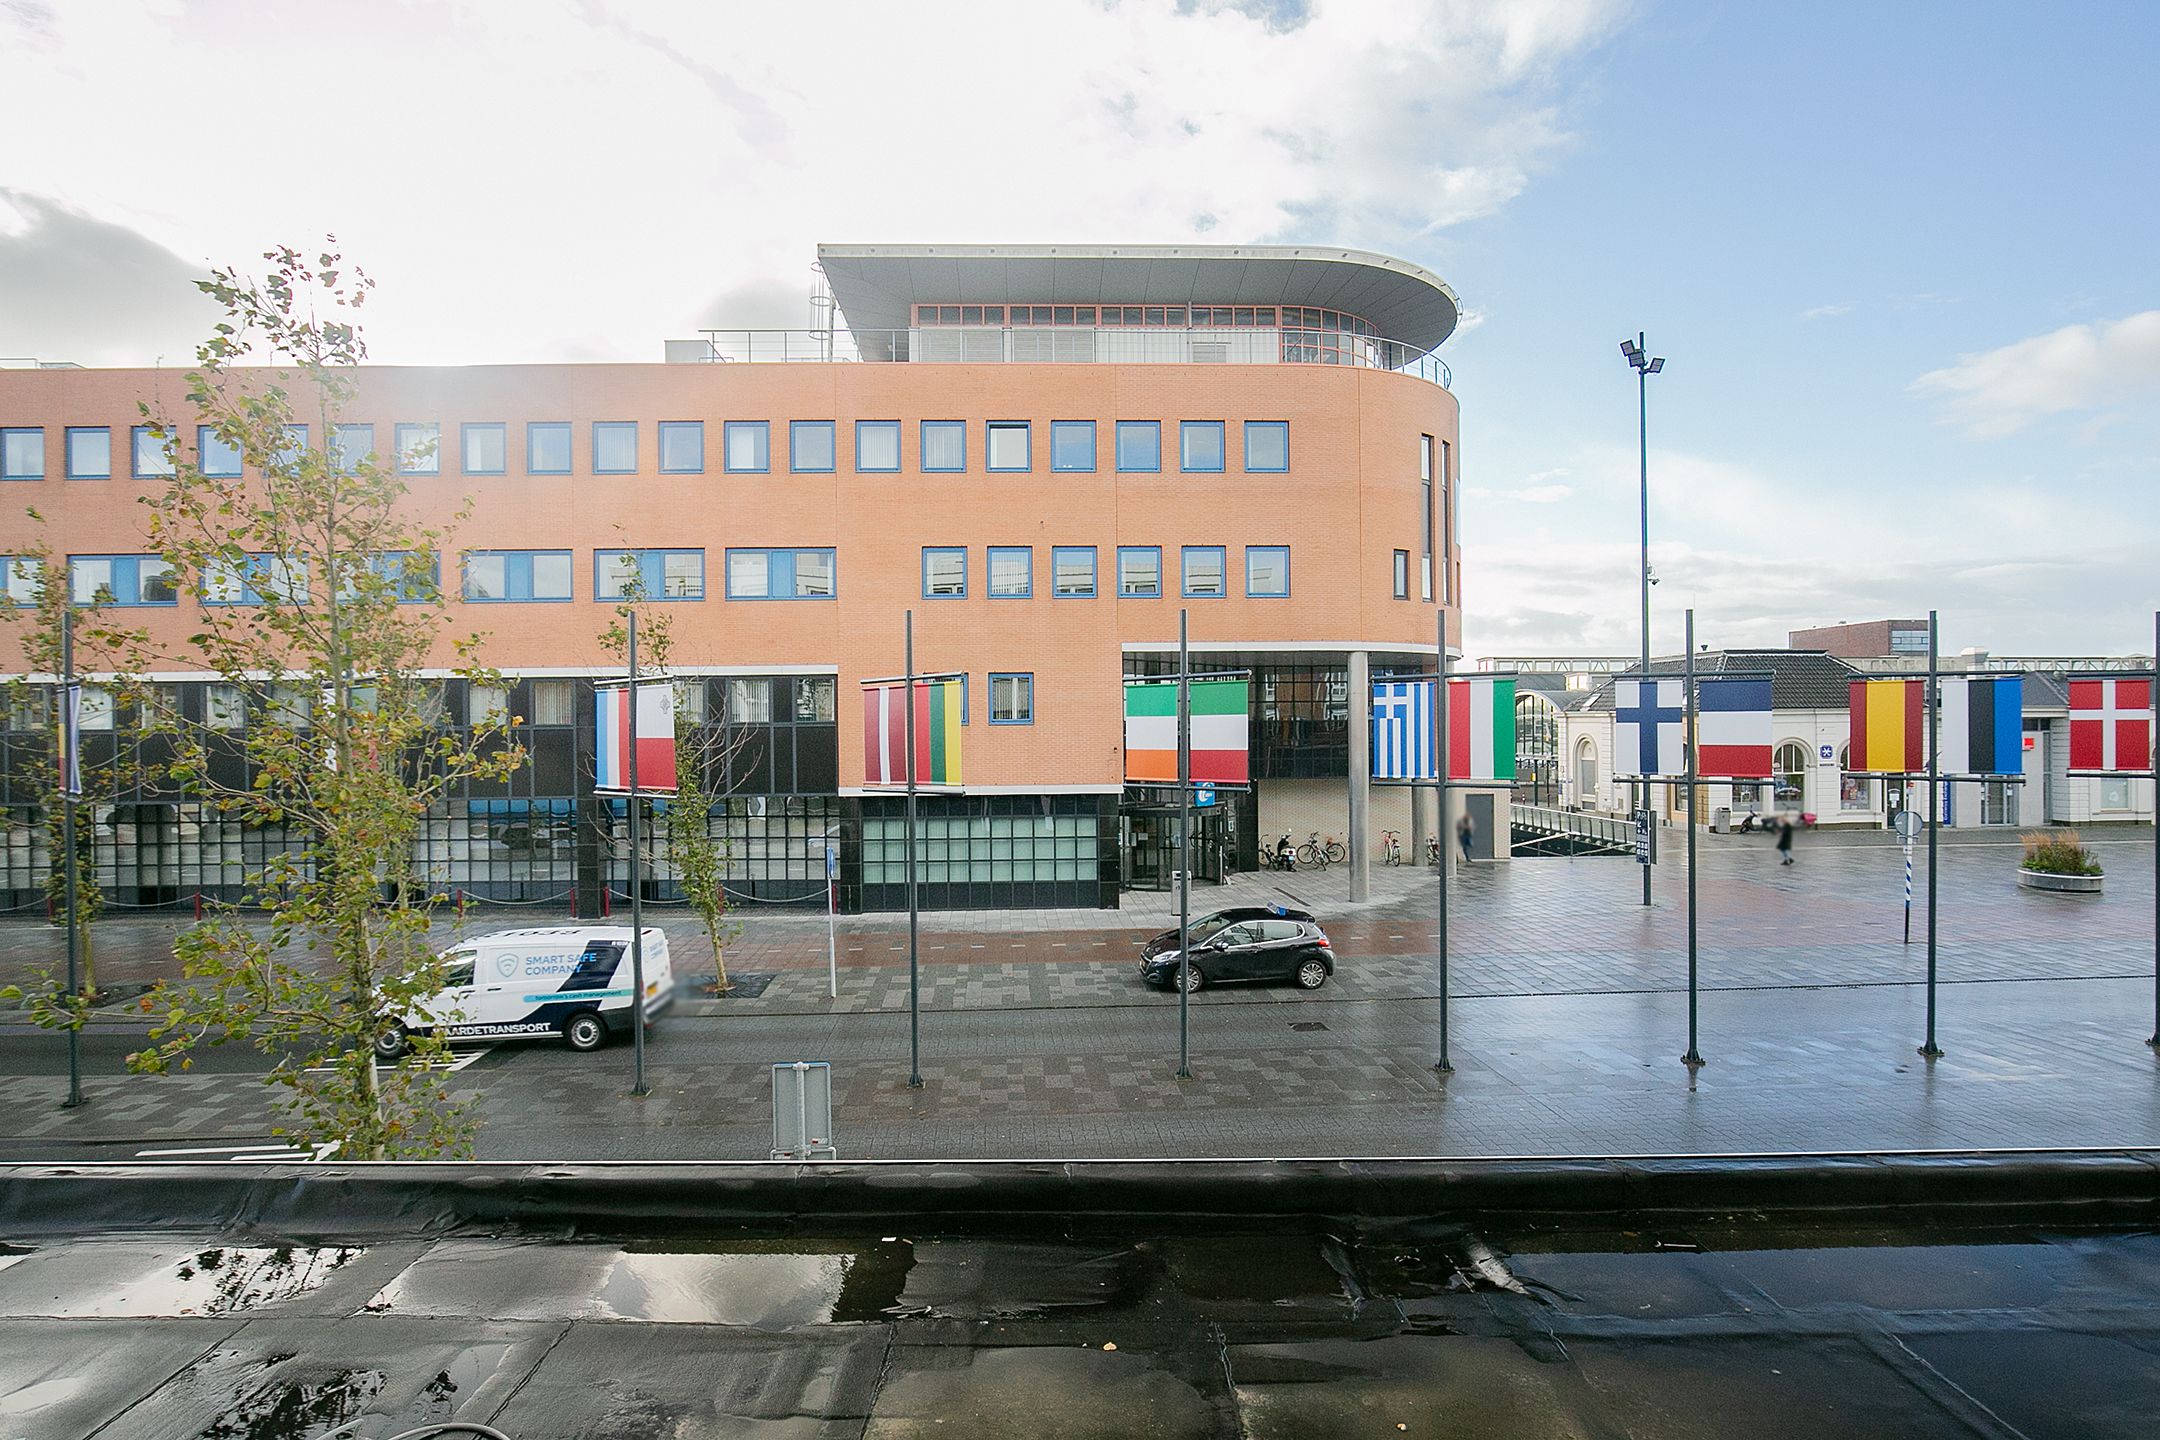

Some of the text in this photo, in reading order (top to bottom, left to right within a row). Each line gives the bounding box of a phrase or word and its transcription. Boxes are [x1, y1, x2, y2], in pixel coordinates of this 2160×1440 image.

[525, 952, 597, 966] SMART SAFE
[525, 963, 583, 976] COMPANY
